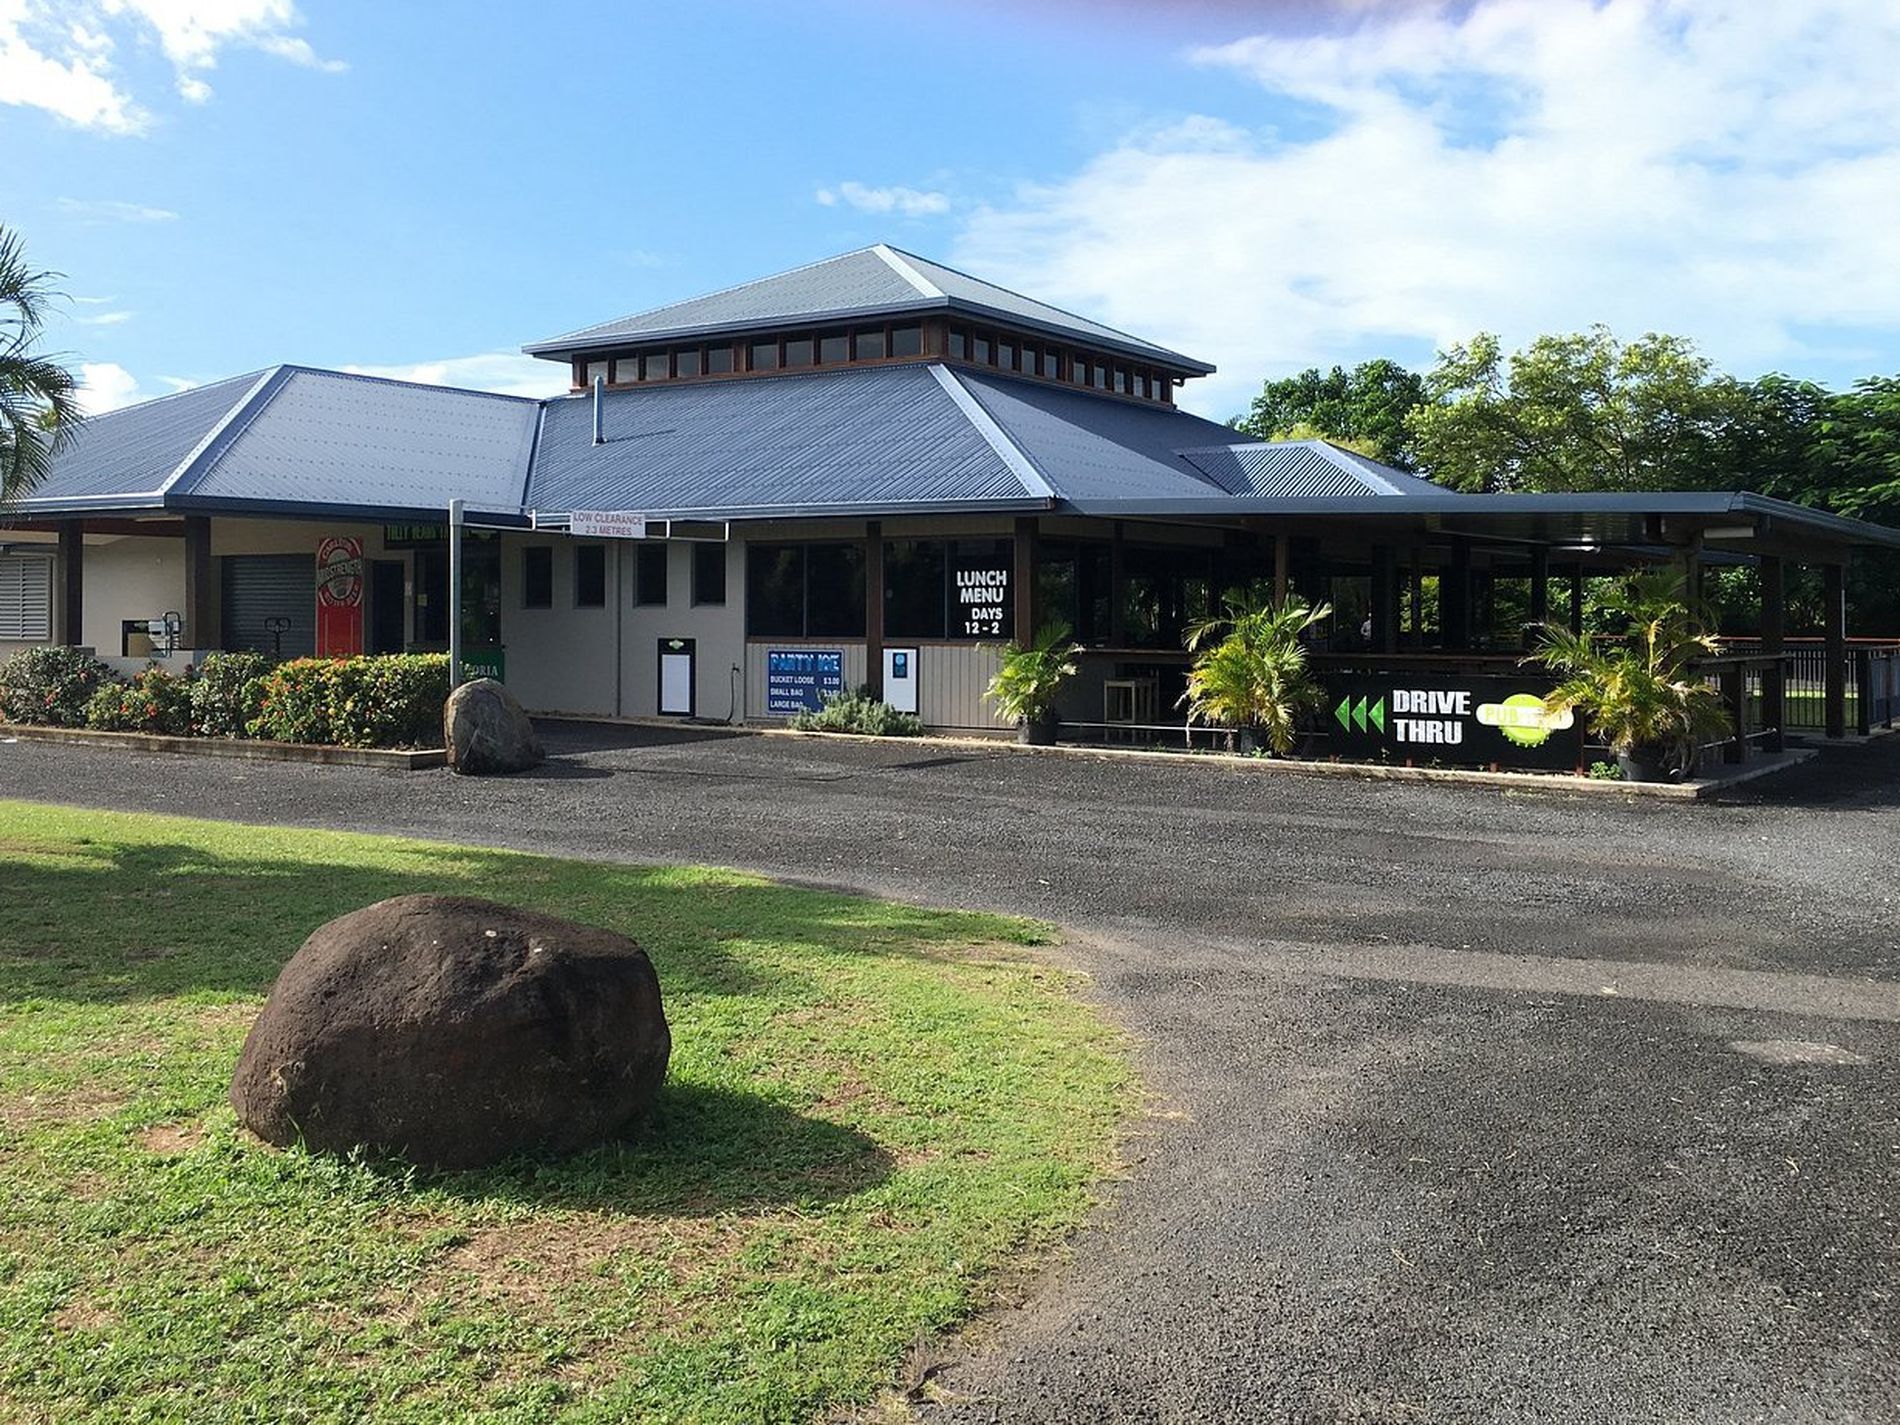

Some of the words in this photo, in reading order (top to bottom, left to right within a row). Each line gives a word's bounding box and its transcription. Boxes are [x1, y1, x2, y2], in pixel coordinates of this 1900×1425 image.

[573, 512, 593, 522] LOW
[594, 513, 642, 526] CLEARANCE
[599, 526, 632, 536] METRES
[957, 570, 1007, 586] LUNCH
[960, 587, 1003, 603] MENU
[972, 607, 1003, 620] DAYS
[770, 653, 814, 672] PARTY
[817, 653, 840, 673] ICE
[770, 675, 793, 684] BUCKET
[794, 676, 815, 685] LOOSE
[770, 687, 790, 696] SMALL
[790, 688, 804, 697] BAG
[770, 700, 790, 709] LARGE
[1392, 689, 1472, 715] DRIVE
[1485, 705, 1519, 723] PUB
[1392, 718, 1464, 745] THRU
